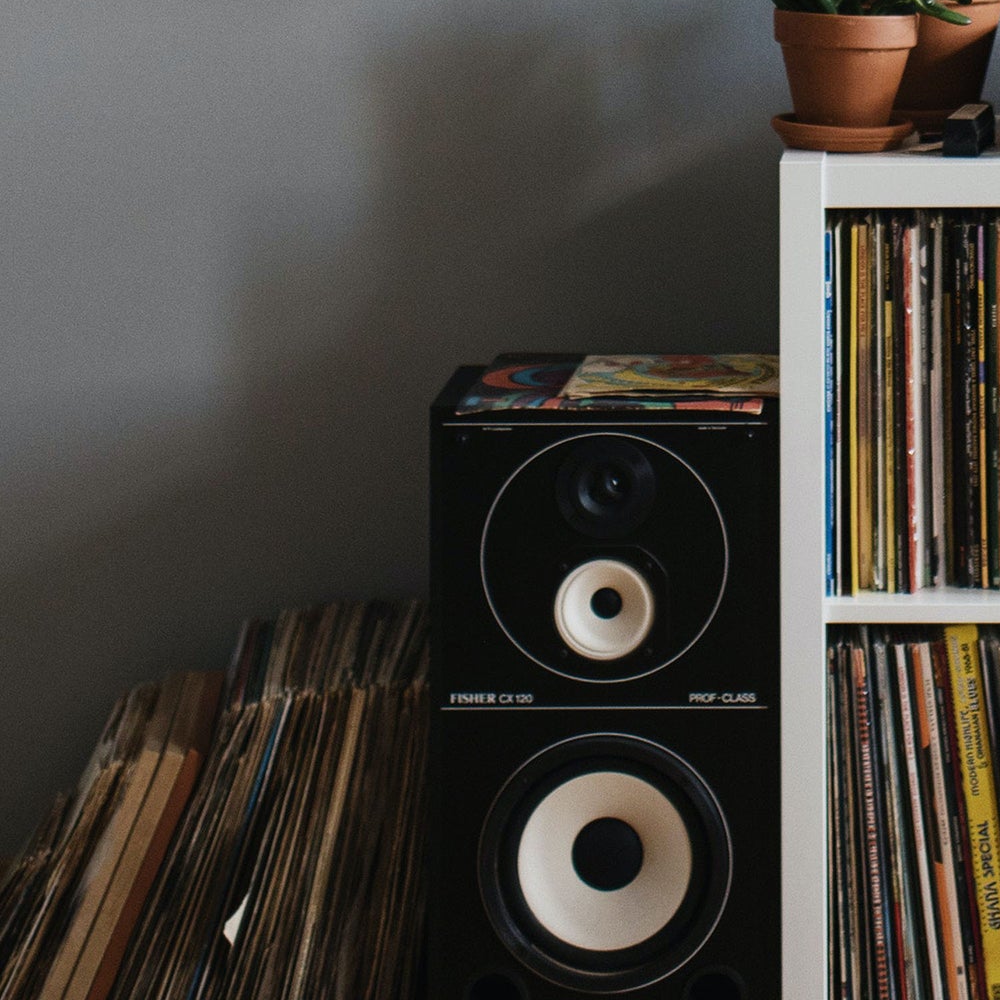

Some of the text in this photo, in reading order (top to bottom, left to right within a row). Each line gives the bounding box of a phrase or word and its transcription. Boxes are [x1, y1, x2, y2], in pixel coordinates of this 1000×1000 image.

[449, 693, 534, 704] FISHER CX 120
[688, 692, 756, 704] PROF-CLASS
[967, 678, 980, 714] BLUES
[972, 714, 984, 760] GHANAIAN
[966, 752, 980, 796] MODERN
[977, 820, 994, 879] SPECIAL
